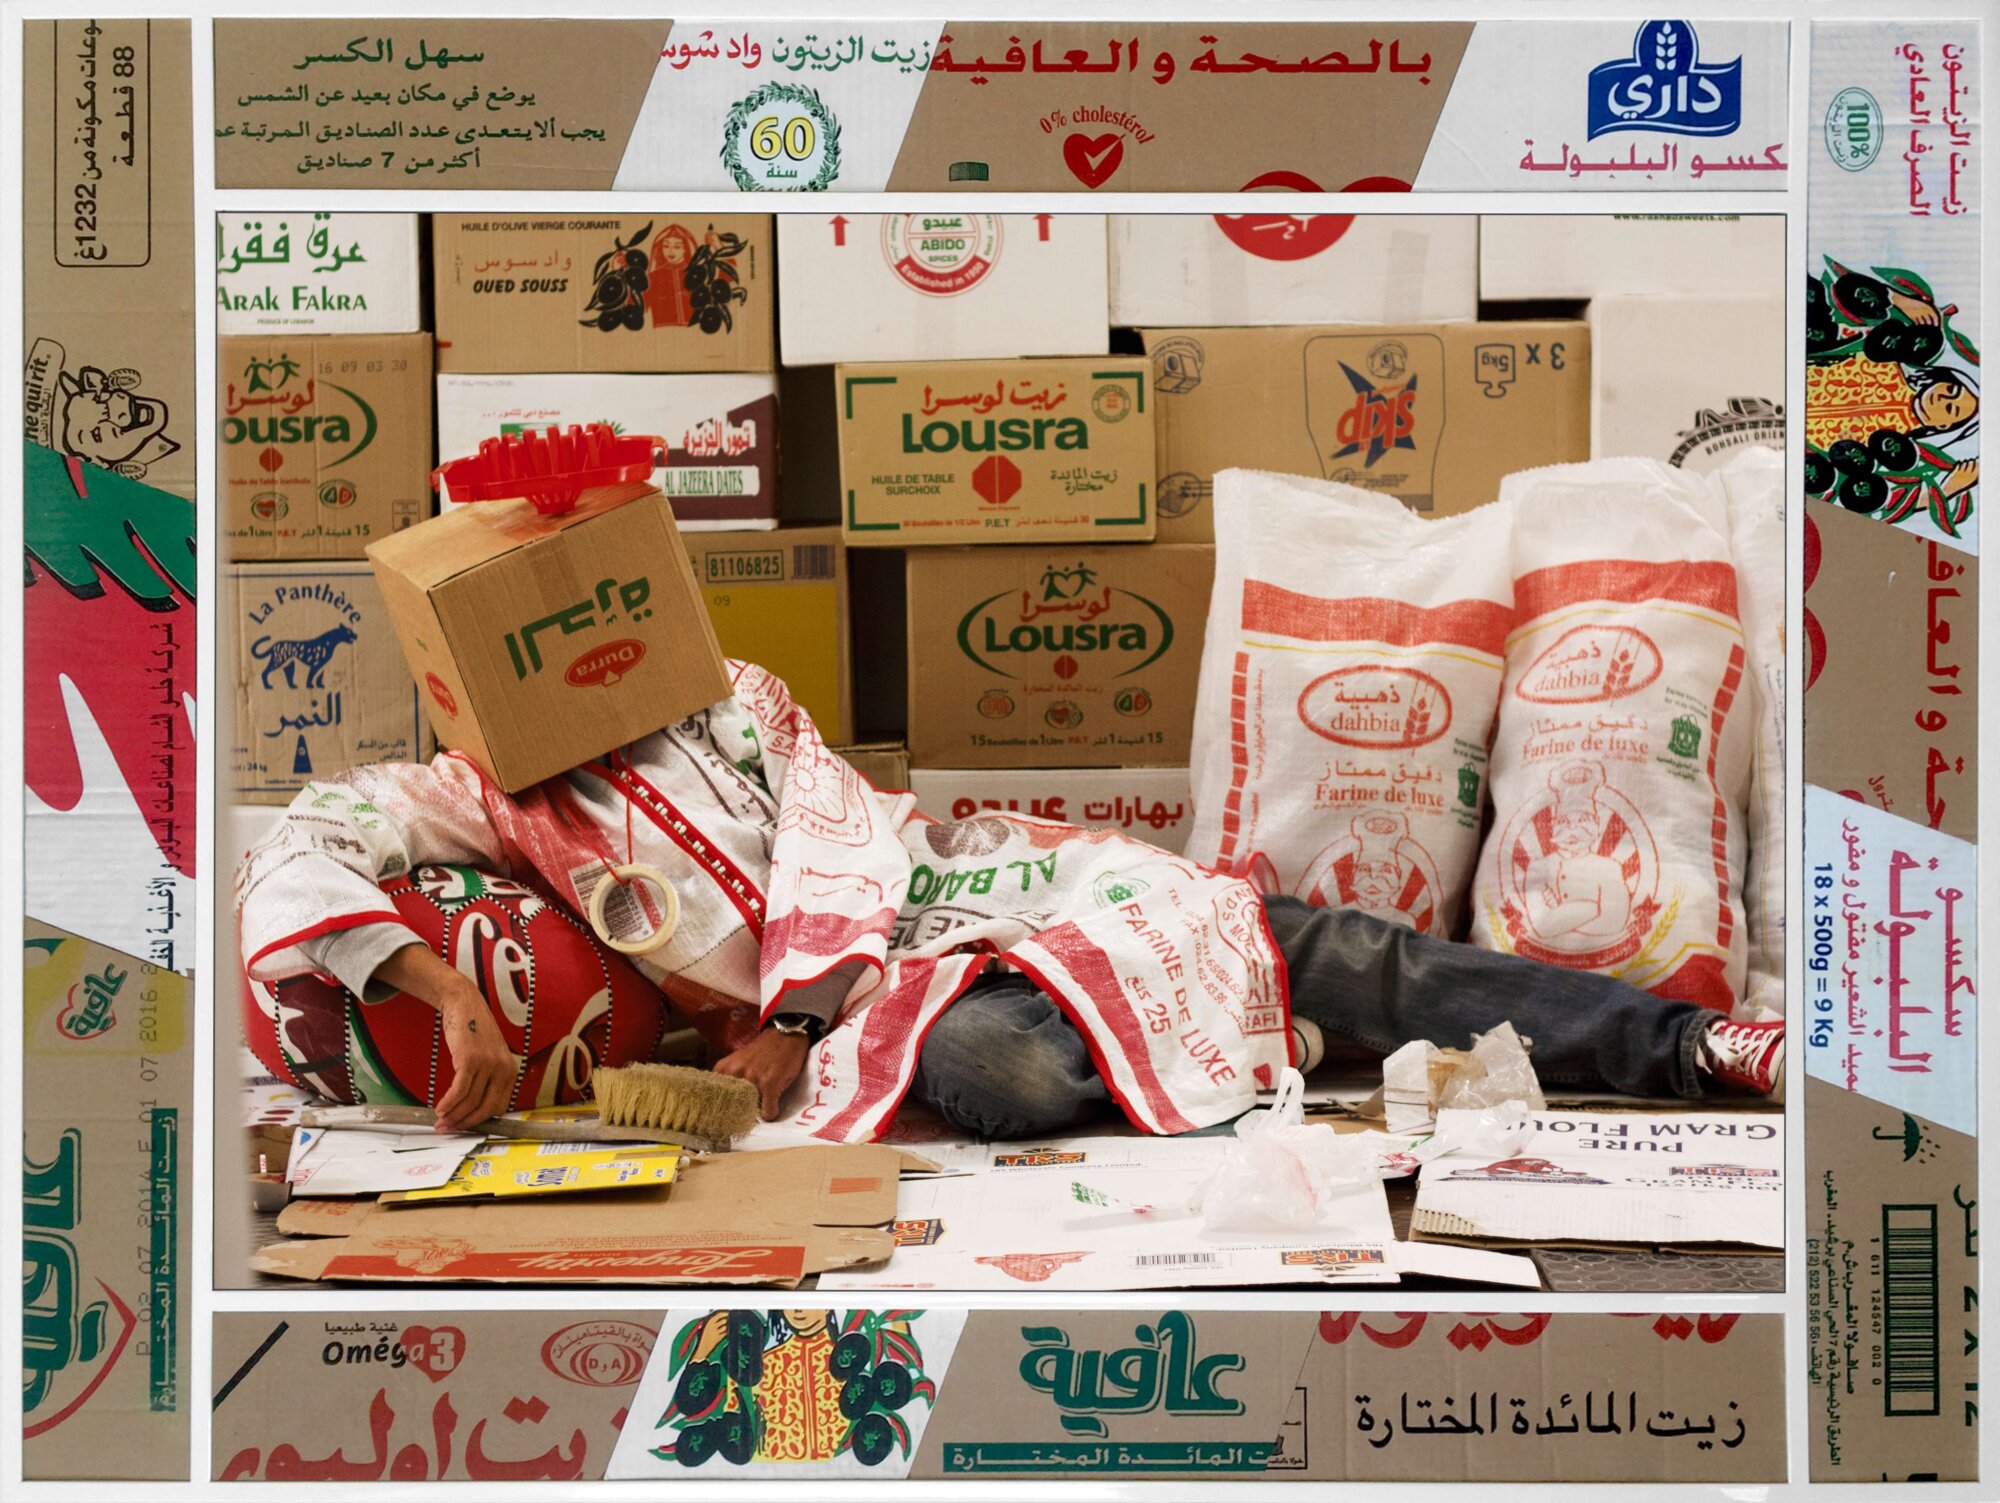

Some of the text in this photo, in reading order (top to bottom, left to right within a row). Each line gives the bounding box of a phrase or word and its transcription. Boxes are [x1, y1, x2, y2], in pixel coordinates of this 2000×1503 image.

[294, 37, 484, 71] سهل الكسر
[728, 33, 761, 69] واد
[772, 35, 864, 72] الزيتون
[871, 39, 931, 73] زيت
[929, 34, 1432, 86] بالصحة و العافية
[113, 46, 135, 166] 88 قطعة
[237, 84, 536, 111] يوضع في مكان بعيد عن الشمس
[1608, 74, 1722, 119] داري
[74, 80, 102, 147] مكونة
[1072, 105, 1155, 144] cholestérol
[1894, 43, 1934, 216] الصرف العادي
[1941, 43, 1971, 216] زيت الزيتون
[241, 120, 606, 143] يجب عدد الصناديق المرتبة
[750, 116, 815, 161] 60
[1846, 102, 1871, 159] 100%
[83, 151, 102, 180] من
[296, 147, 481, 174] أكثر من 7 صناديق
[766, 162, 797, 179] سنة
[1519, 139, 1678, 179] البلبولة
[461, 222, 489, 232] HUILE
[531, 221, 565, 231] VIERGE
[568, 220, 621, 230] COURANTE
[923, 218, 962, 231] عبيدو
[307, 212, 367, 273] عرق
[921, 239, 965, 250] ABIDO
[474, 257, 537, 273] سوس
[544, 250, 572, 271] واد
[473, 278, 568, 293] OUED SOUSS
[318, 362, 333, 374] 16
[1481, 351, 1509, 373] 5kg
[1550, 341, 1566, 371] 3
[226, 378, 315, 415] لوسرا
[921, 379, 1067, 416] زيت لوسرا
[903, 413, 1088, 453] Lousra
[665, 470, 743, 494] AL JAZEERA DATES
[872, 474, 955, 484] HUILE DE TABLE
[886, 485, 940, 495] SURCHOIX
[356, 525, 370, 536] 15
[985, 519, 1010, 527] P.E.T
[710, 556, 780, 577] 81106825
[249, 582, 361, 625] La Panthère
[1020, 586, 1112, 622] لوسرا
[985, 616, 1146, 653] Lousra
[575, 643, 636, 679] Durra
[1545, 640, 1601, 671] ذهبية
[1334, 681, 1400, 710] ذهبية
[1534, 668, 1602, 693] dahbia
[264, 691, 341, 737] النمر
[1330, 712, 1400, 732] dahbia
[1914, 708, 1948, 732] و
[970, 735, 986, 746] 15
[1147, 732, 1163, 744] 15
[1522, 734, 1649, 758] Farine de luxe
[1319, 760, 1443, 784] دقيق ممتاز
[1084, 796, 1184, 829] بهارات
[1316, 784, 1445, 808] Farine de luxe
[1841, 817, 1868, 1036] الشعير مفتول و مفور
[1809, 862, 1833, 1048] 18 x 500g 9 Kg
[1873, 849, 1940, 1073] البلبولة
[1935, 887, 1976, 1038] سكسو
[1119, 902, 1237, 1088] FARINE DE LUXE
[139, 990, 159, 1082] 07 2016
[1142, 1003, 1172, 1036] 25
[156, 1116, 176, 1174] زيت
[1579, 1138, 1683, 1153] PURE
[1651, 1121, 1777, 1141] GRAM
[509, 1248, 773, 1276] Longevity
[1871, 1288, 1881, 1335] 124547
[322, 1331, 456, 1372] Oméga 3
[1871, 1345, 1882, 1368] 002
[1019, 1310, 1246, 1439] عافية
[1356, 1391, 1746, 1451] زيت المائدة المختارة
[953, 1446, 1241, 1471] المائدة المختارة
